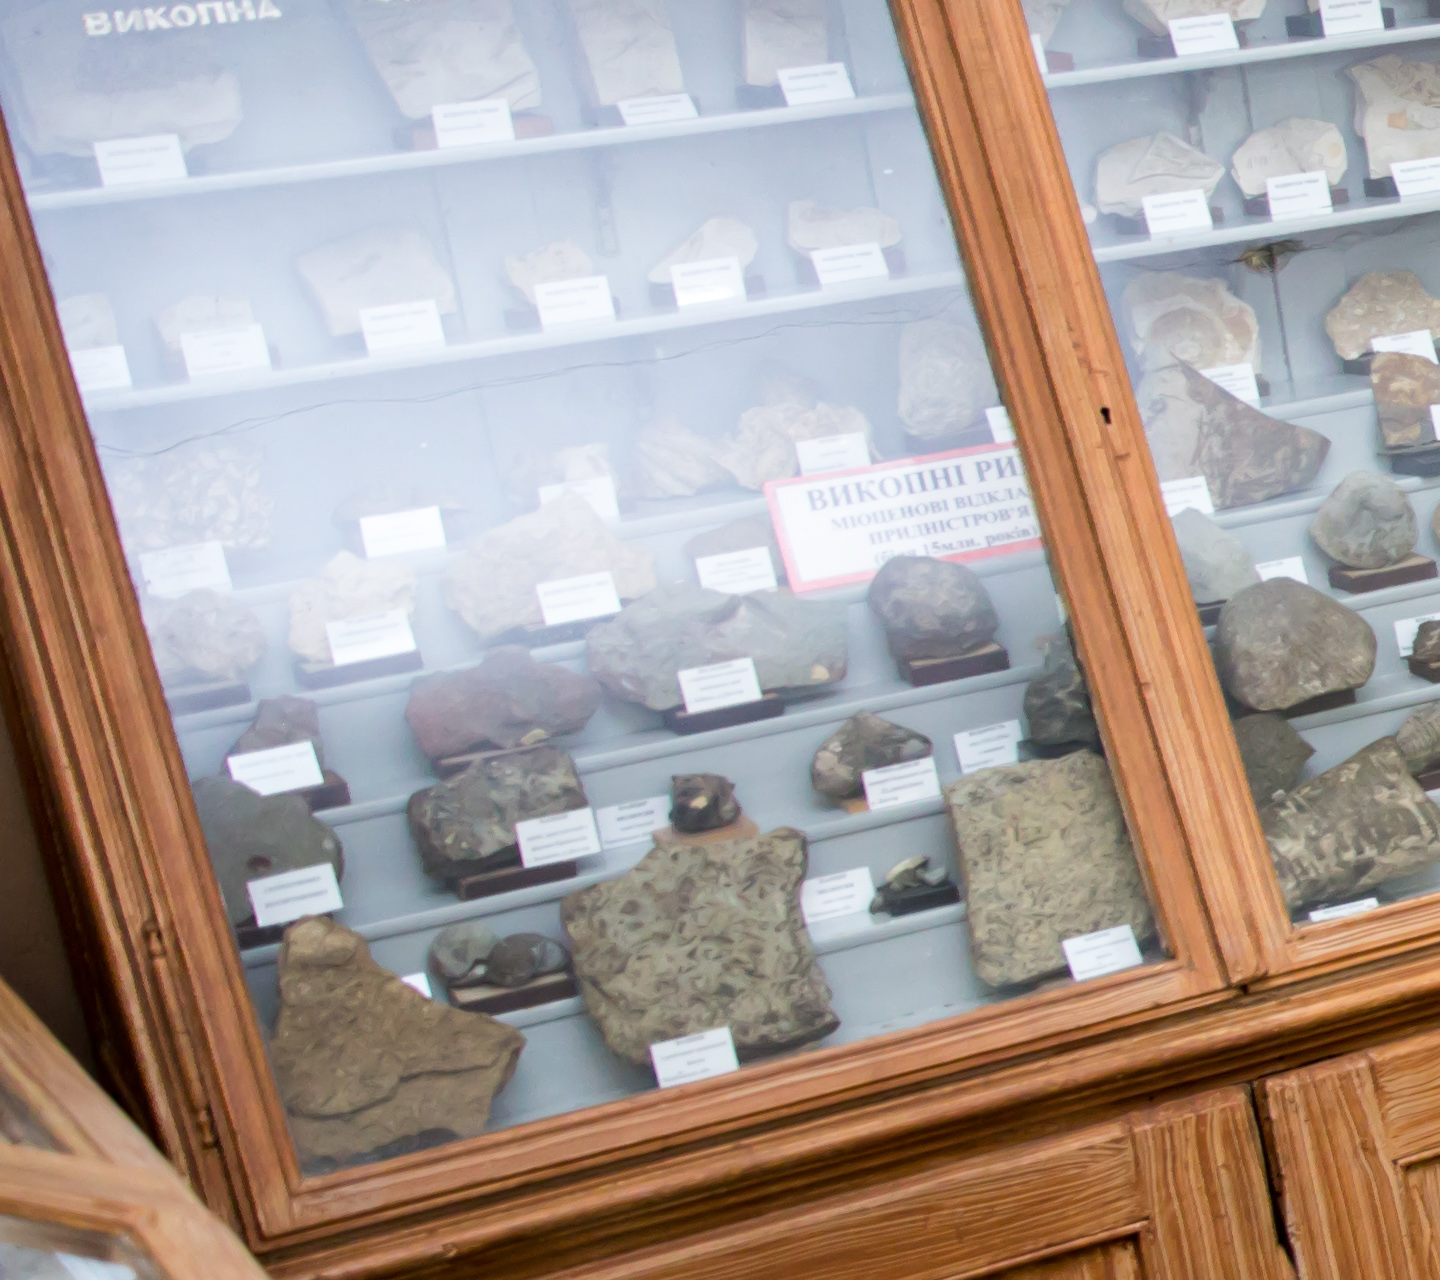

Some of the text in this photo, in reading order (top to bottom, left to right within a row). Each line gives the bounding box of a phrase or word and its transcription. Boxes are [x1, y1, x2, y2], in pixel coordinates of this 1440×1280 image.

[807, 455, 1023, 512] ВИКОПНІ РИ
[831, 486, 1030, 531] МІОЦЕНОВІ ВІДКЛА
